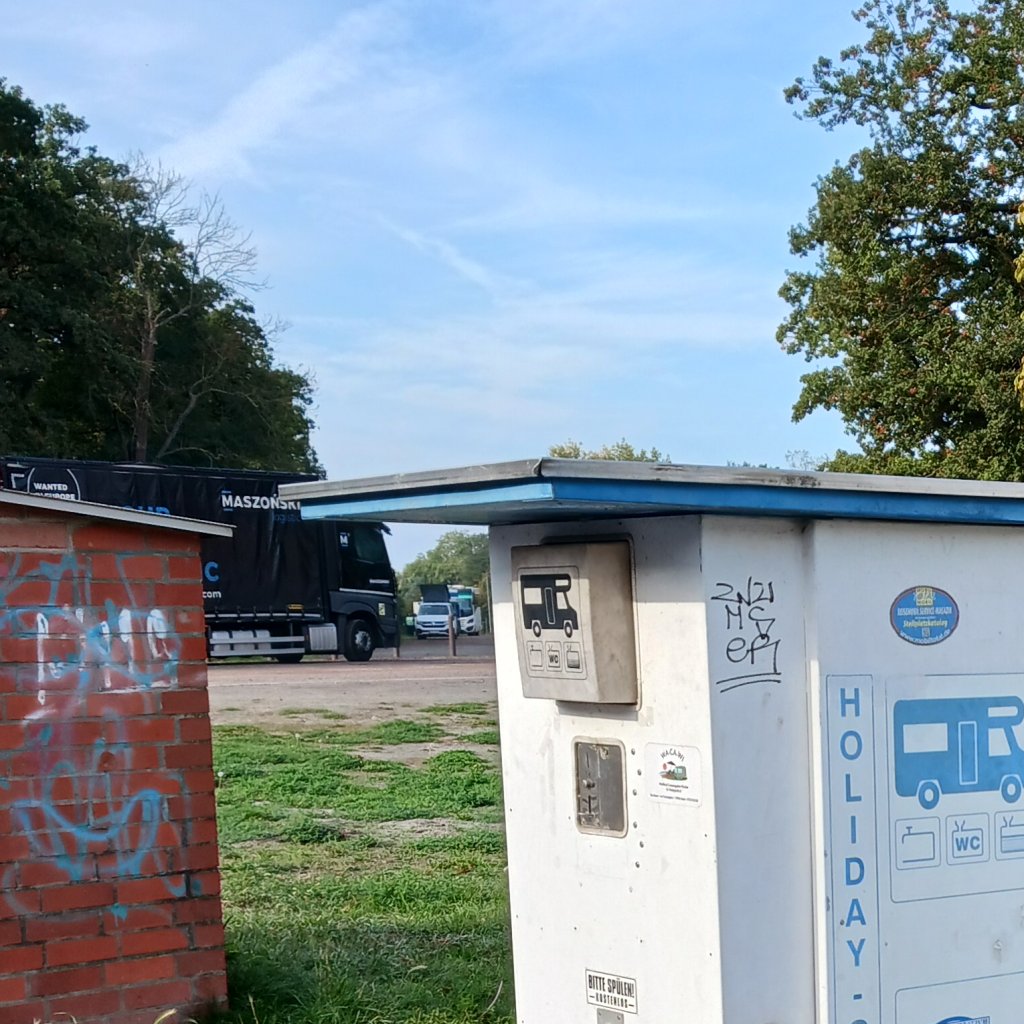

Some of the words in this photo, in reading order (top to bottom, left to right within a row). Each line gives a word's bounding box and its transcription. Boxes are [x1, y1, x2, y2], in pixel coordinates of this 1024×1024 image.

[33, 482, 68, 491] WANTED
[955, 835, 981, 852] WC
[588, 974, 605, 991] BITTE
[607, 977, 634, 998] SPÜLEN!
[596, 992, 628, 1008] KOSTENLOS
